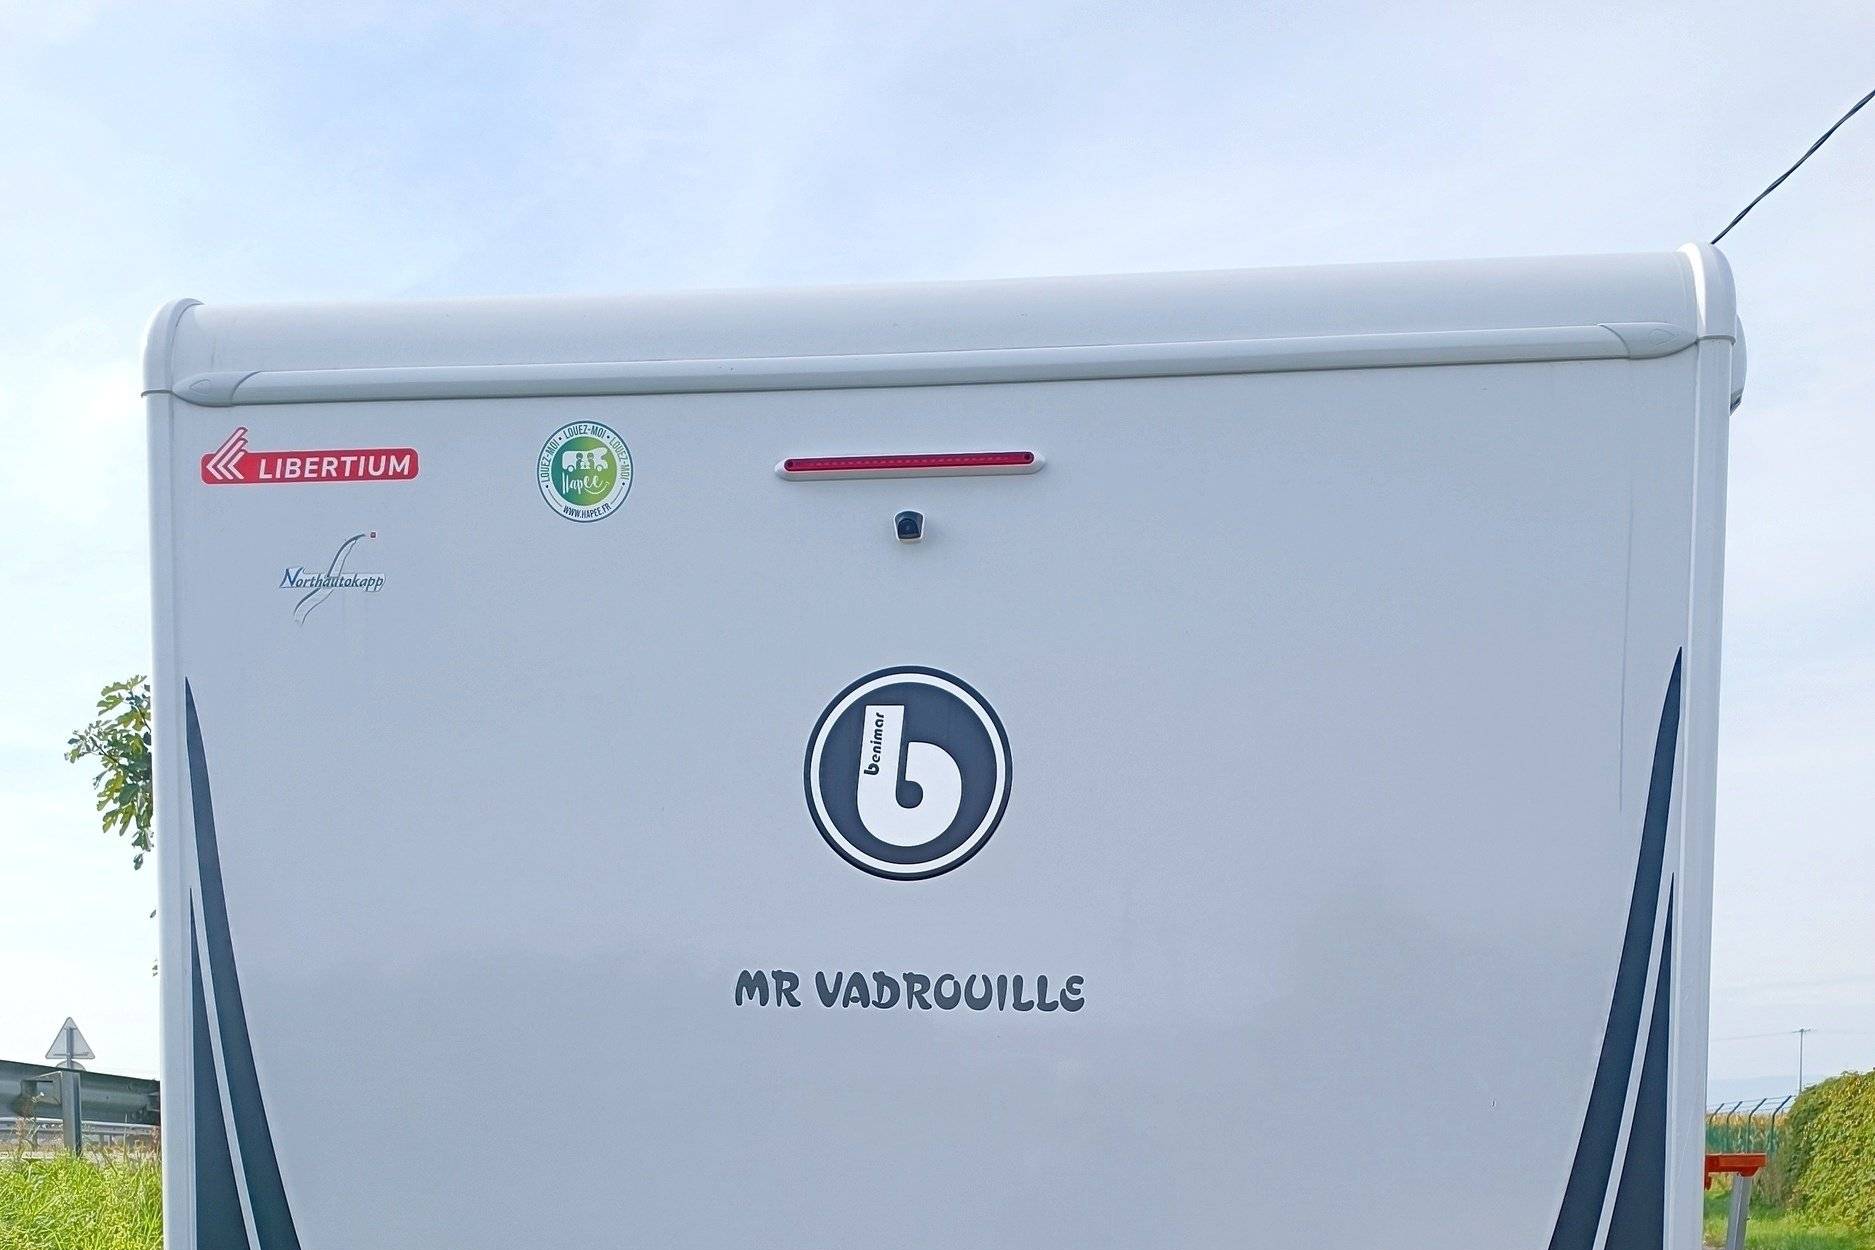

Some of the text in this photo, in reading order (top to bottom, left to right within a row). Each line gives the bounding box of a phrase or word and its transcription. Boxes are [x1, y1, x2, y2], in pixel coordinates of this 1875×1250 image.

[563, 424, 607, 439] LOUEZ-MOI
[258, 454, 411, 479] LIBERTIUM
[540, 438, 560, 483] LOUEZ-MOI
[563, 502, 612, 519] WWW.HAPEE.FR
[279, 567, 384, 591] Northautokapp
[863, 711, 885, 776] benimar
[735, 969, 1086, 1012] MR VADROUILLE
